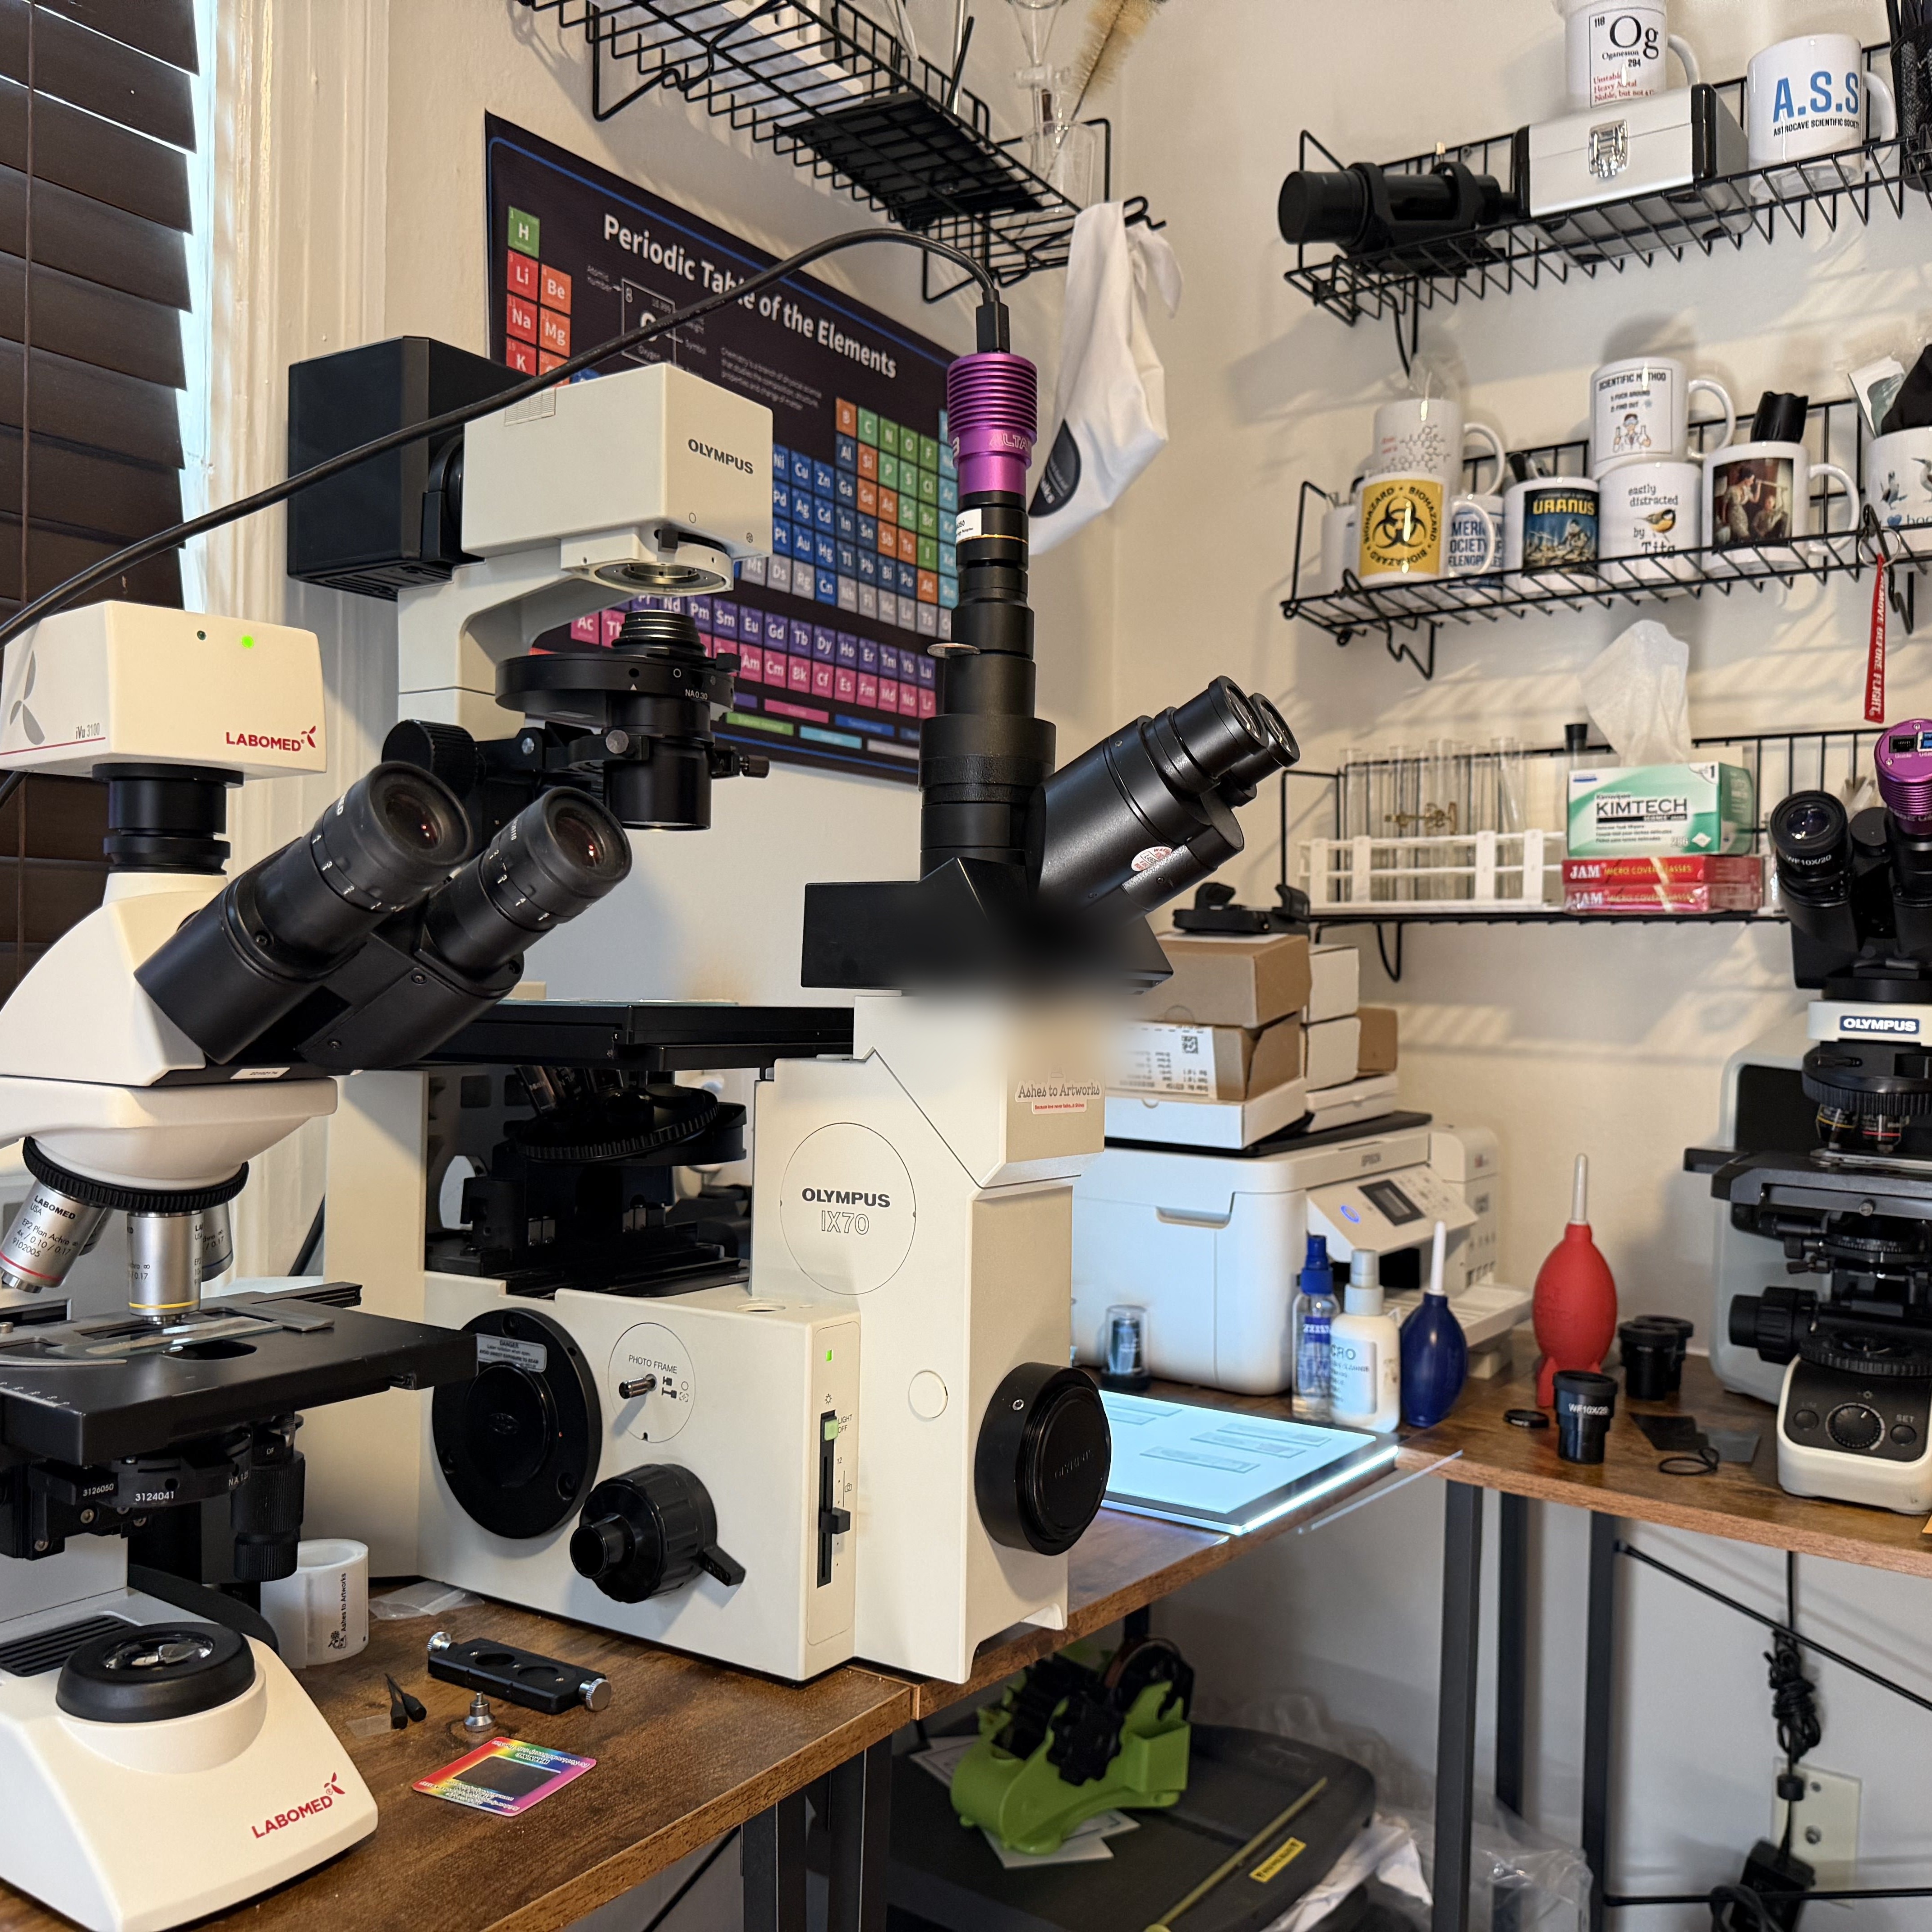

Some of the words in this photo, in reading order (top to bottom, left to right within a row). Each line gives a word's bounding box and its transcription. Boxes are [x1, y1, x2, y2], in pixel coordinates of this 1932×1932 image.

[1610, 15, 1659, 60] Og
[1811, 118, 1843, 128] SCIENTIFIC
[519, 222, 529, 241] H
[516, 266, 529, 285] Li
[547, 279, 565, 299] Be
[604, 213, 695, 281] Periodic
[700, 259, 755, 310] Tabe
[759, 294, 782, 321] of
[783, 303, 814, 338] the
[817, 318, 897, 379] Elements
[512, 308, 531, 330] Na
[545, 322, 566, 347] Mg
[516, 355, 526, 372] K
[1636, 372, 1666, 381] MTHOD
[864, 421, 871, 434] C
[687, 438, 754, 475] OLYMPUS
[795, 463, 809, 478] Cu
[817, 473, 830, 488] Zn
[1533, 499, 1595, 515] URANUS
[1630, 496, 1678, 507] distracted
[796, 500, 810, 519] Ag
[817, 509, 831, 524] Cd
[1633, 527, 1645, 539] by
[775, 528, 787, 544] Pt
[796, 536, 810, 551] Au
[819, 544, 833, 563] Hg
[773, 565, 787, 581] Ds
[819, 580, 833, 594] Cn
[577, 615, 594, 631] Ac
[690, 603, 710, 621] Pm
[716, 609, 735, 627] Sm
[745, 617, 759, 633] Eu
[768, 624, 785, 640] Gd
[794, 630, 808, 645] Tb
[817, 638, 832, 655] Dy
[840, 644, 855, 658] Ho
[863, 649, 874, 662] Er
[882, 654, 897, 669] Tm
[742, 654, 760, 671] Am
[766, 661, 784, 676] Cm
[792, 667, 807, 682] Bk
[816, 673, 829, 687] Cf
[840, 678, 852, 693] Es
[860, 683, 875, 698] Fm
[75, 726, 86, 741] iVu
[87, 722, 100, 738] 3100
[225, 731, 302, 752] LABOMED
[1596, 798, 1687, 816] KIMTECH
[1570, 865, 1600, 879] JAM
[1843, 1018, 1916, 1032] OLYMPUS
[1018, 1084, 1047, 1098] Ashes
[1049, 1085, 1058, 1097] to
[1059, 1082, 1100, 1096] Artworks
[34, 1195, 76, 1219] LABOMED
[801, 1188, 891, 1208] OLYMPUS
[31, 1203, 42, 1215] USA
[22, 1218, 32, 1229] EP2
[33, 1225, 47, 1237] Plan
[48, 1234, 69, 1246] Achro
[820, 1210, 869, 1236] IX70
[12, 1237, 41, 1257] 9102005
[30, 1236, 47, 1248] 0.10
[629, 1354, 652, 1367] PHOTO
[653, 1361, 677, 1374] FRAME
[837, 1425, 847, 1433] OFF
[83, 1483, 114, 1496] 3126050
[135, 1491, 175, 1502] 3124041
[250, 1795, 334, 1840] LABOMED
